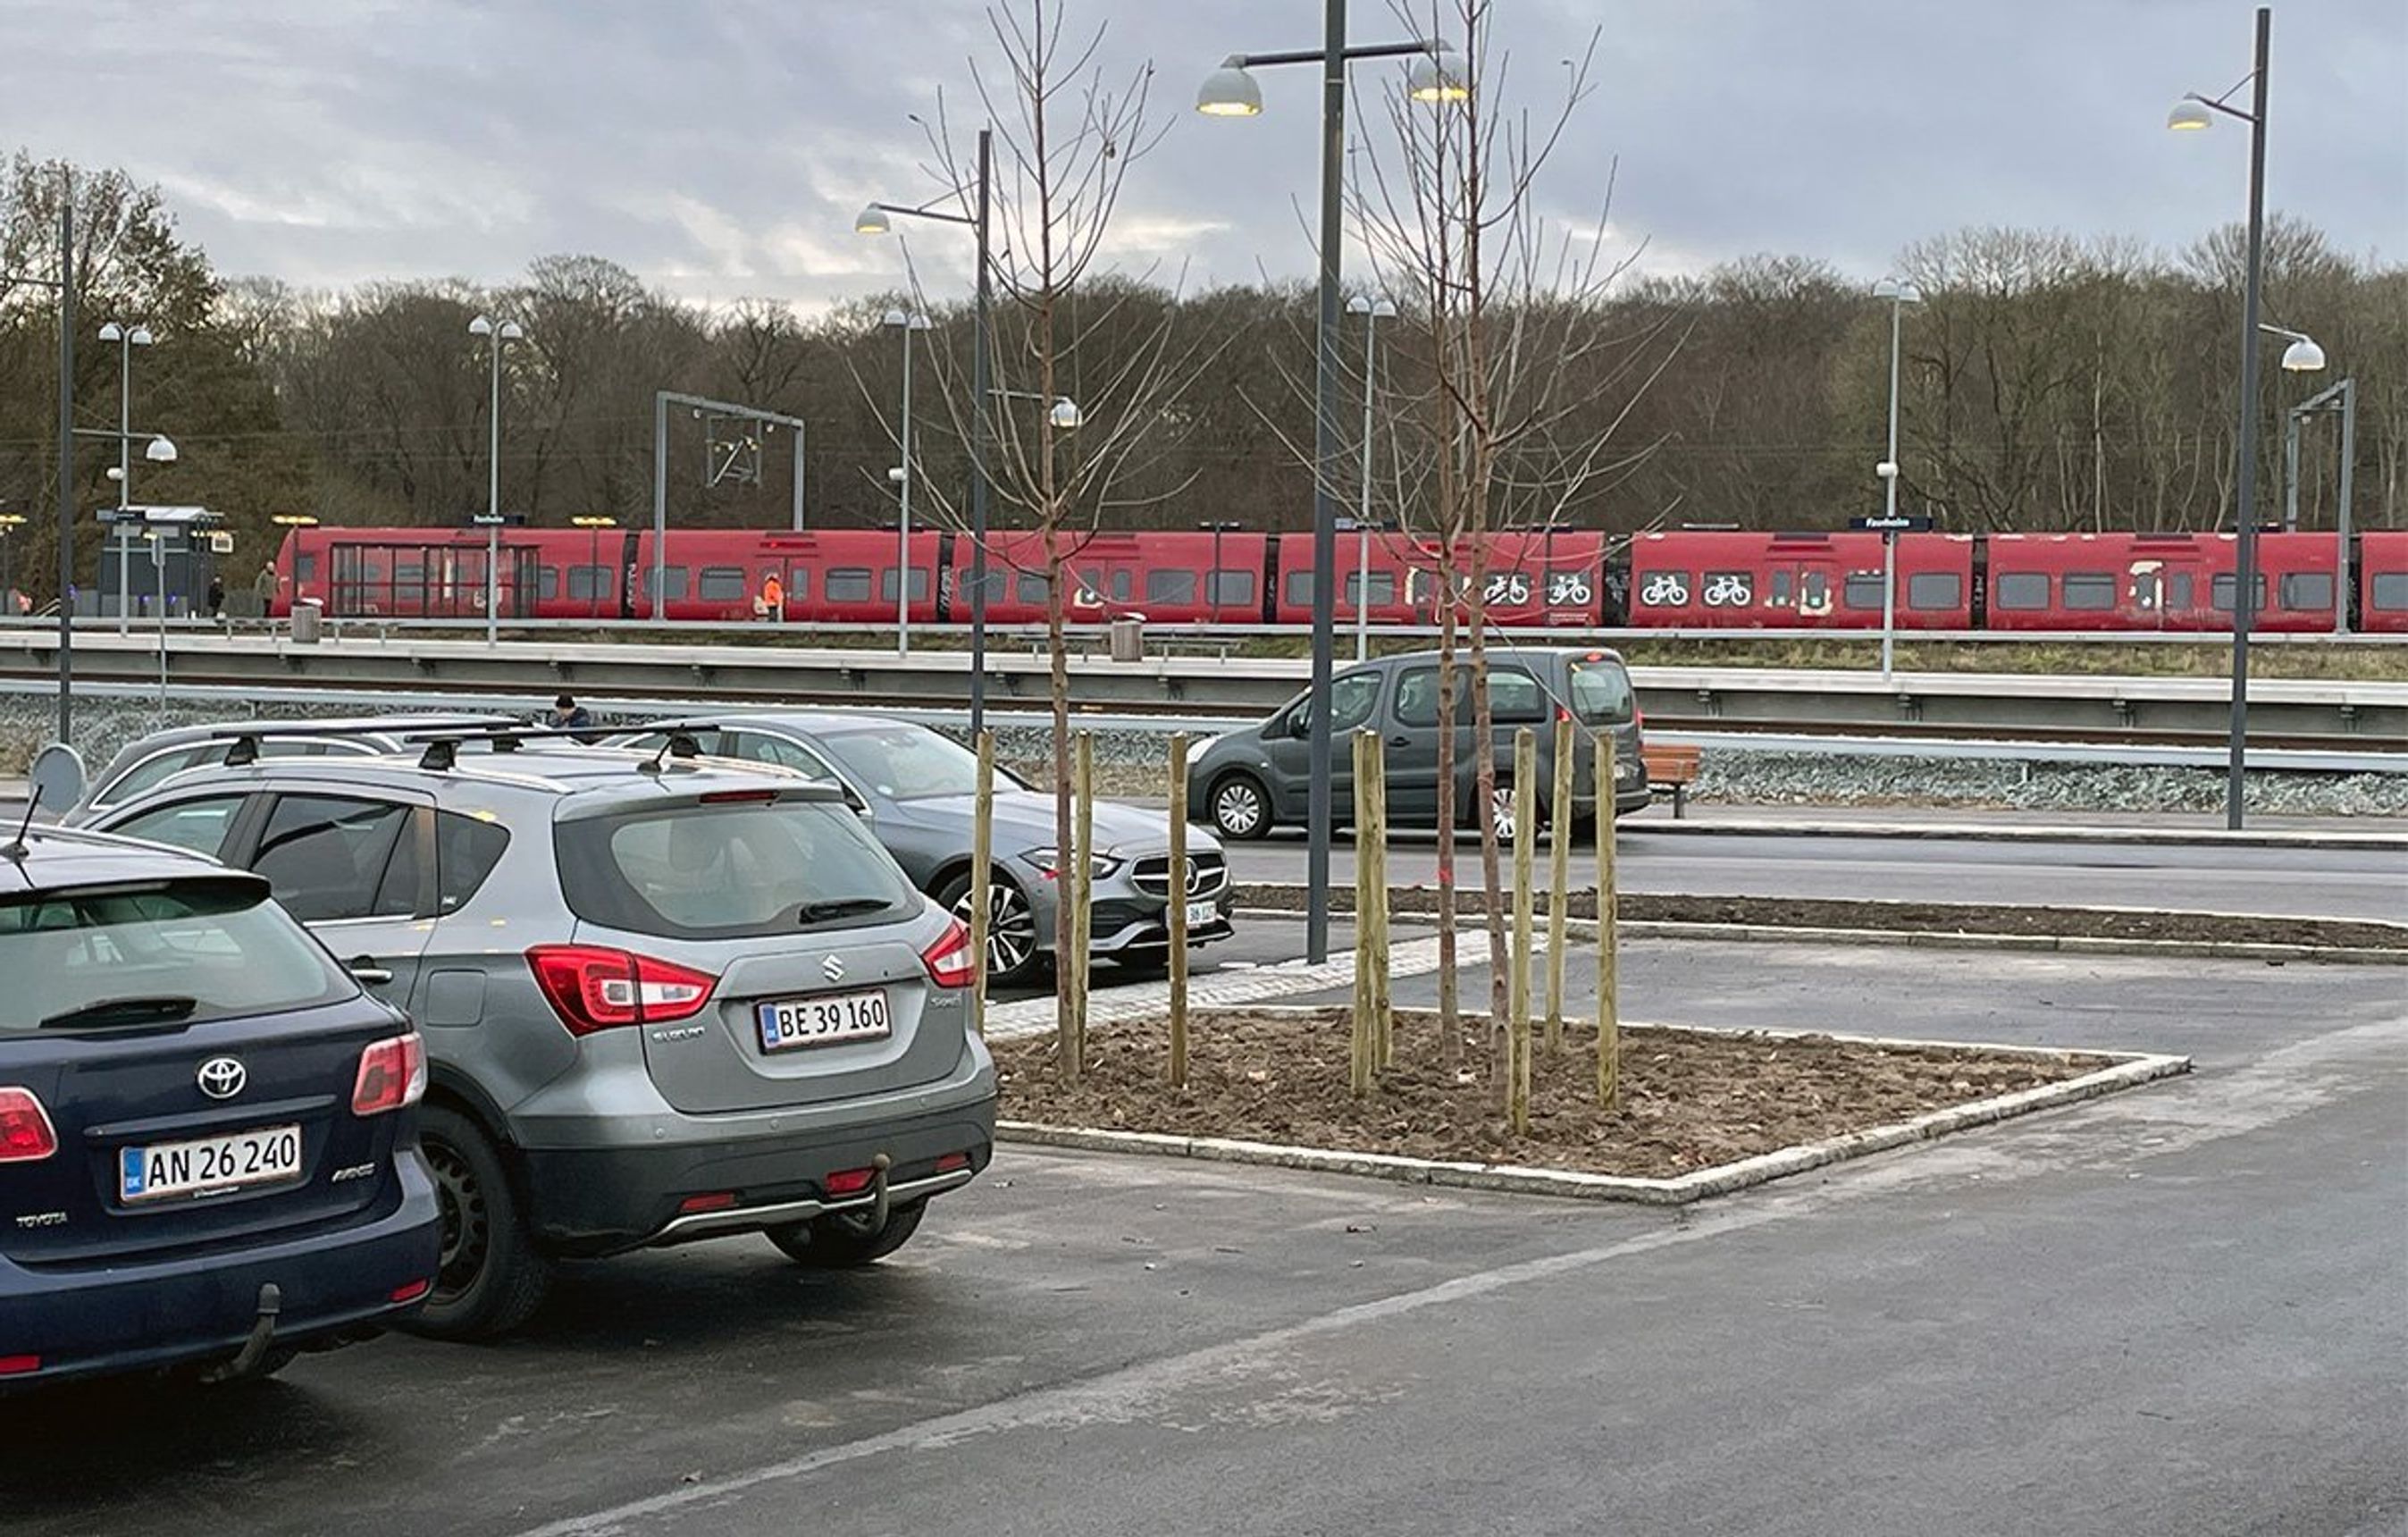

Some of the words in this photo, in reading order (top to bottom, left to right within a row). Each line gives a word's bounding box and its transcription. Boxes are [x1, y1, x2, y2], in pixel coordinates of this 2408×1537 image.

[778, 1007, 810, 1037] BE
[816, 1004, 842, 1034] 39
[847, 998, 885, 1029] 160
[148, 1149, 190, 1188] AN
[198, 1141, 236, 1178] 26
[243, 1133, 296, 1173] 240
[15, 1211, 68, 1229] TOYOTA
